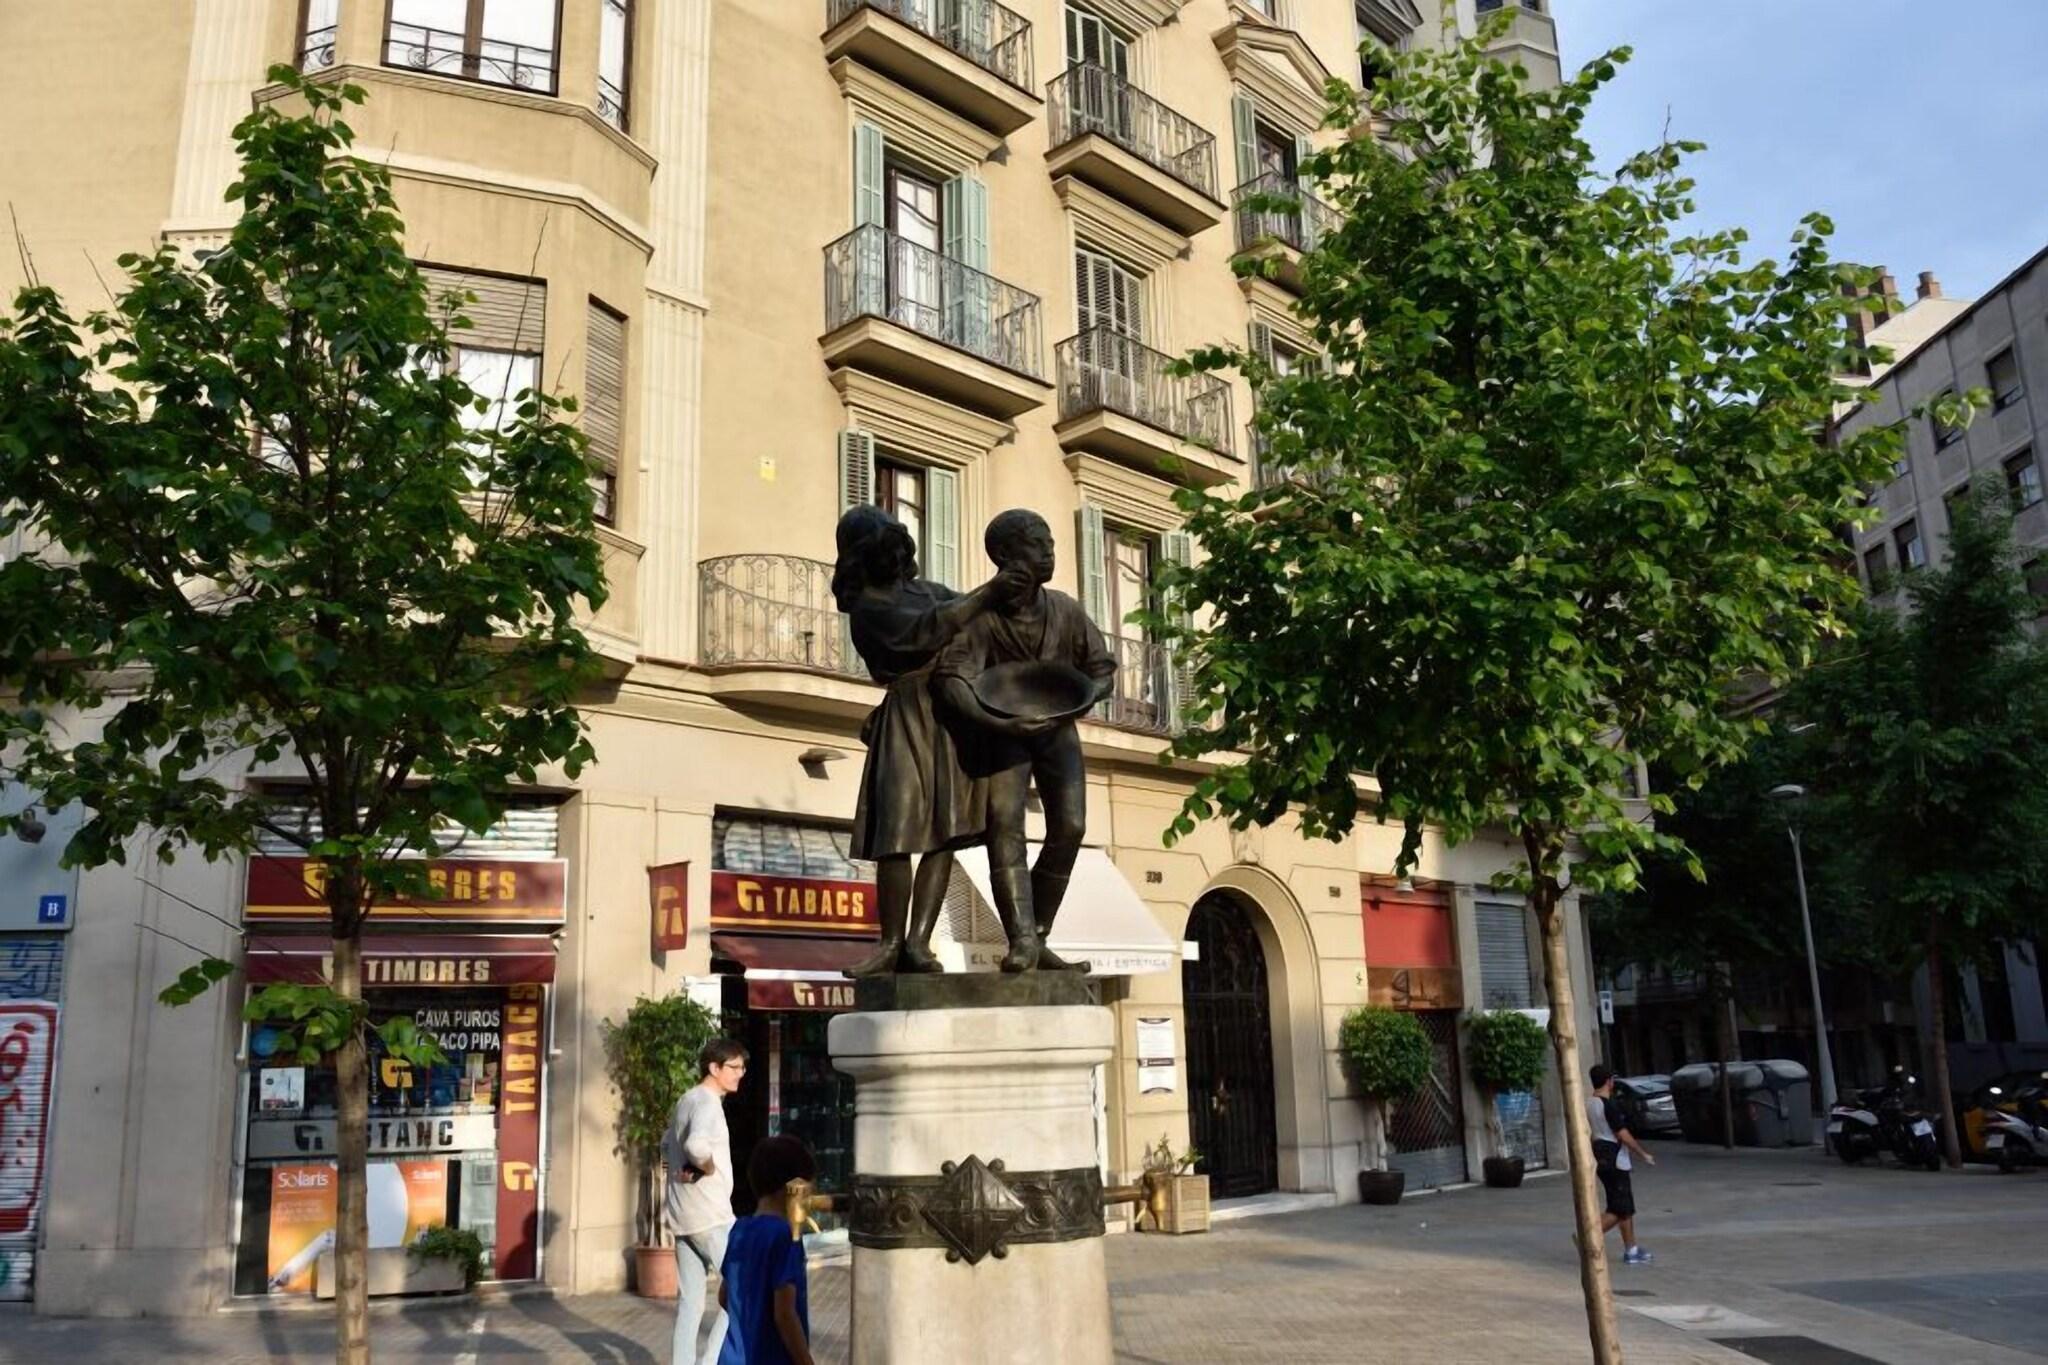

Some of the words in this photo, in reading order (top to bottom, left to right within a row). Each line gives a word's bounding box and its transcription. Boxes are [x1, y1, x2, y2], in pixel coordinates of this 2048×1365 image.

[773, 886, 865, 918] TABACS
[365, 959, 491, 983] TIMBRES
[415, 1009, 450, 1028] CAVA
[455, 1010, 500, 1028] PUROS
[471, 1032, 500, 1051] PIPA
[504, 984, 538, 1115] TABACS
